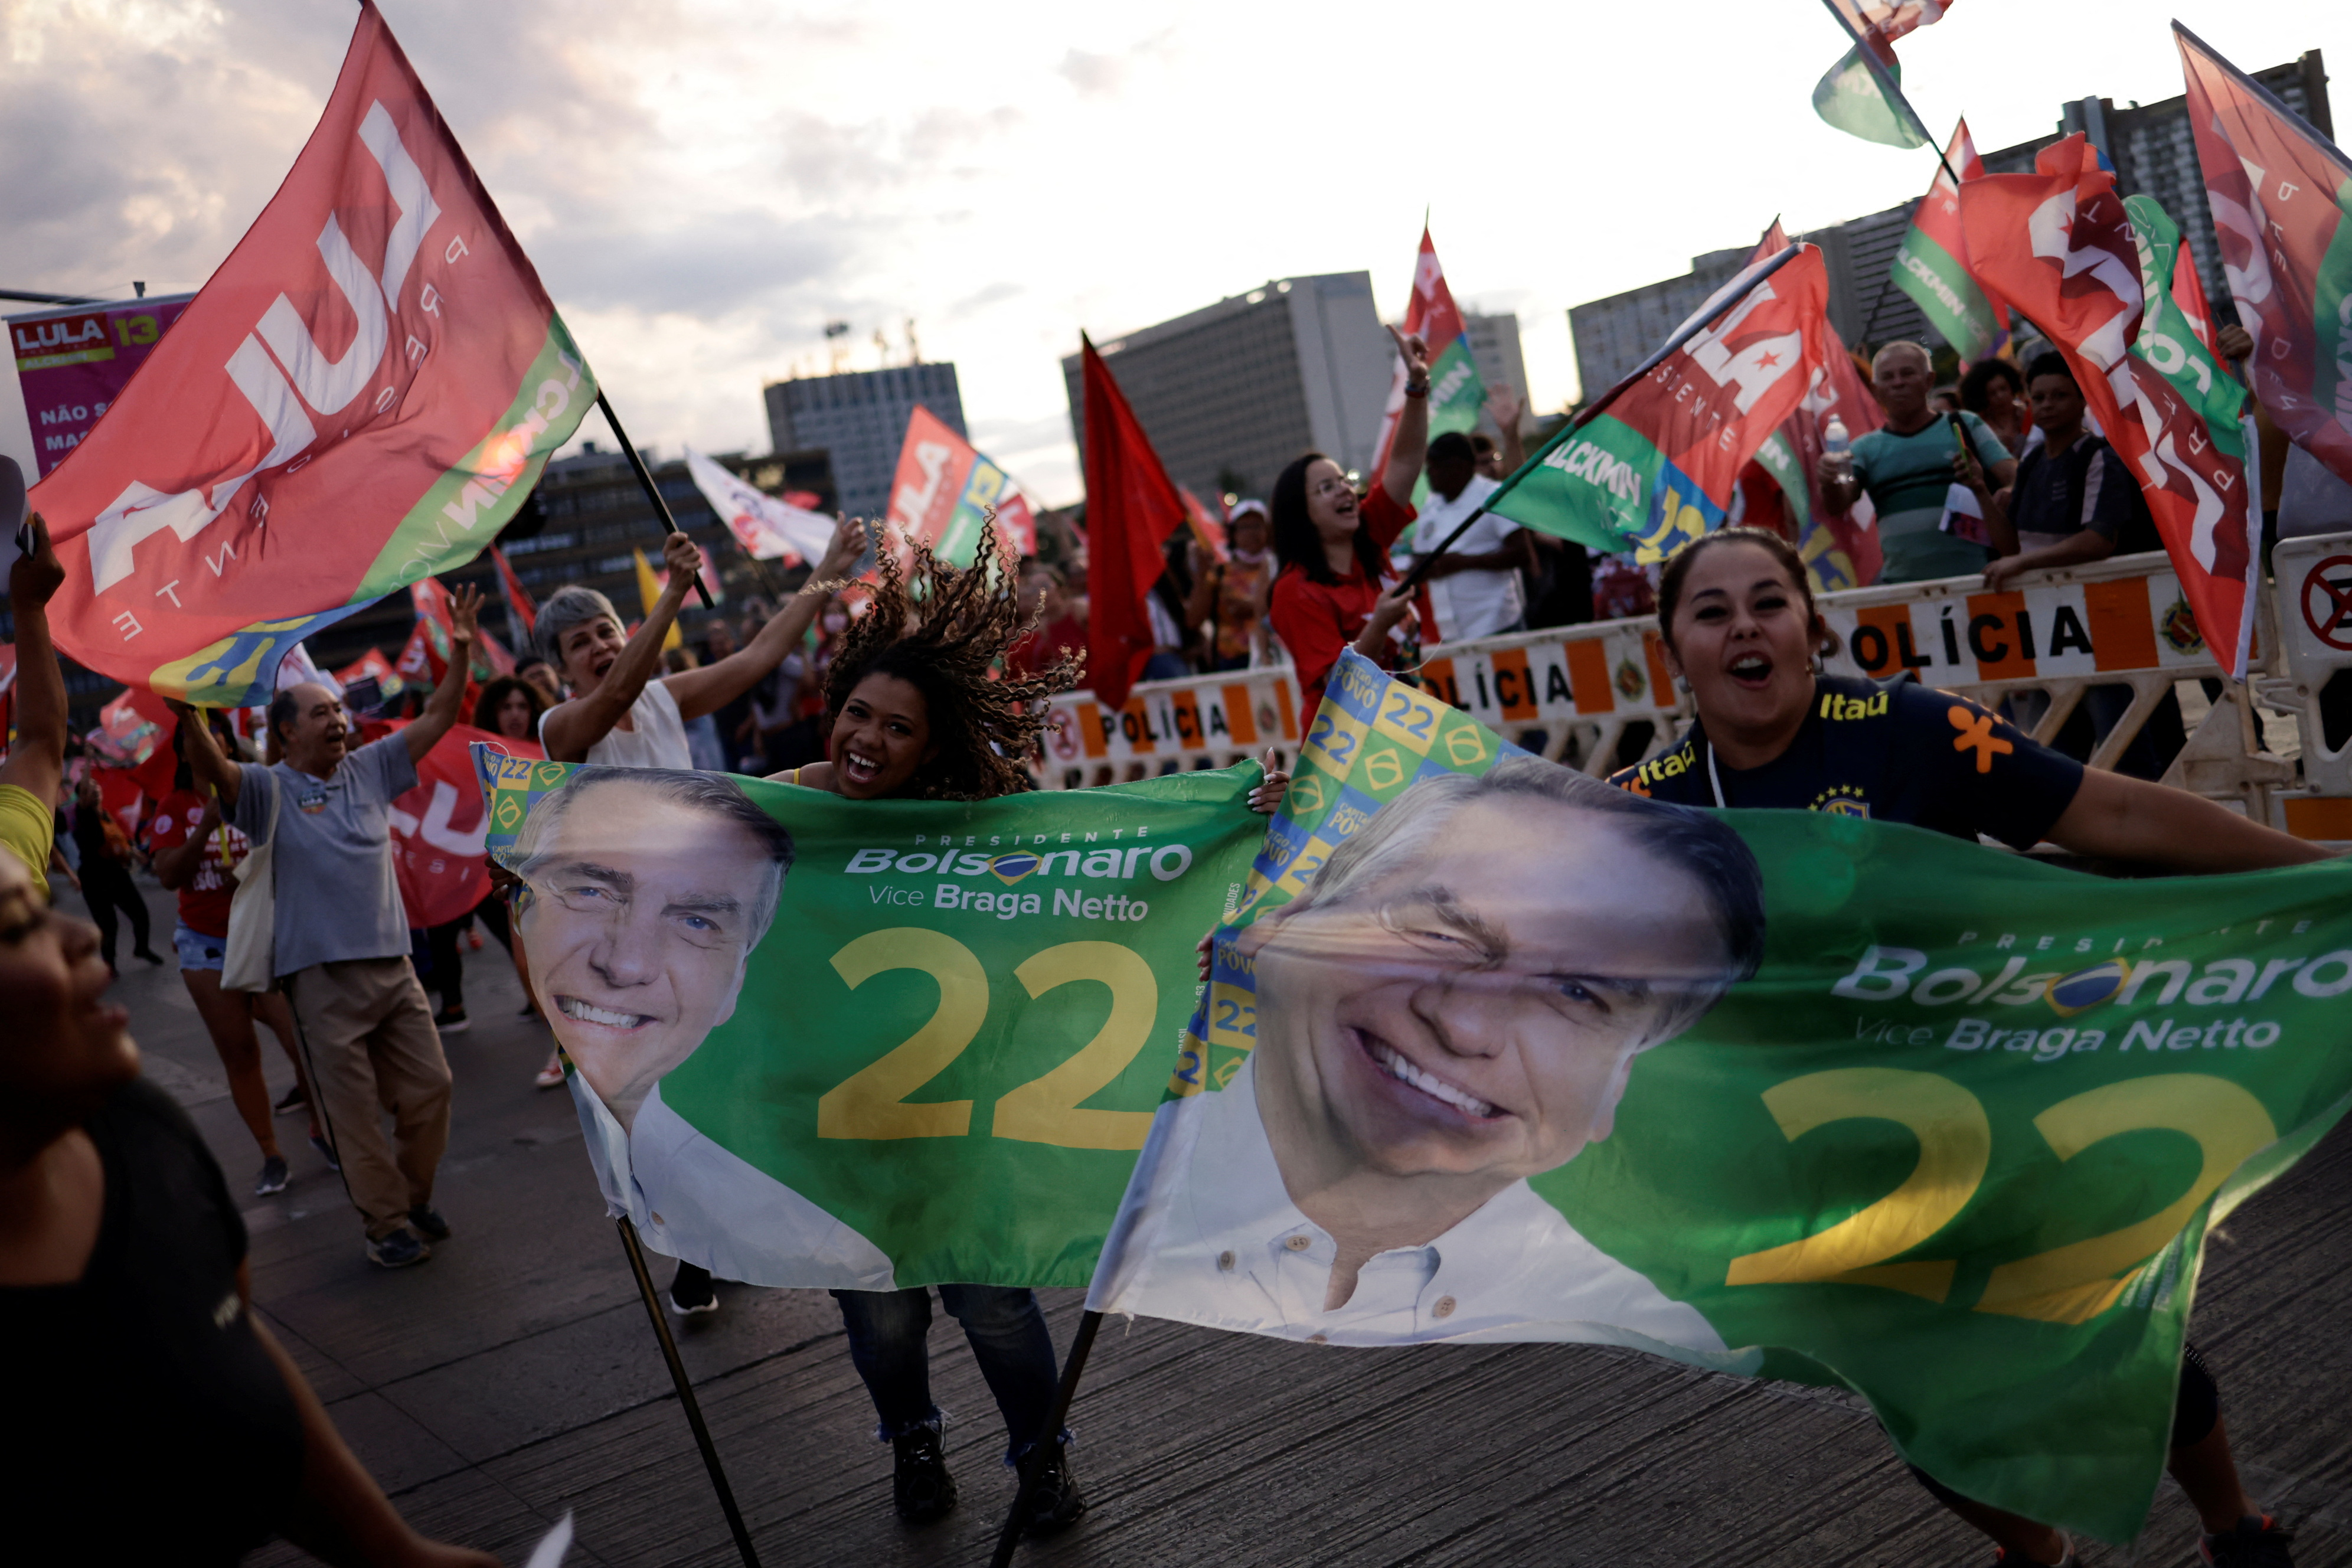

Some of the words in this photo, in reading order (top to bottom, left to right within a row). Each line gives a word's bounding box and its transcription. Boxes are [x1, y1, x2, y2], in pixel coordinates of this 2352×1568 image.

[16, 319, 104, 349] LULA
[115, 315, 159, 347] 13
[40, 404, 87, 425] NÃO
[94, 402, 113, 417] S
[1849, 605, 2094, 671] OLÍCIA
[1332, 665, 1377, 709] POVO
[1819, 691, 1889, 721] Itaú
[1384, 692, 1435, 741] 22
[1308, 714, 1356, 766] 22
[501, 759, 531, 780] 22
[1638, 740, 1697, 786] Itaú
[915, 826, 1148, 847] PRESIDENTE
[844, 844, 1193, 884] Bolsonaro
[869, 885, 924, 906] Vice
[934, 884, 1041, 920] Braga
[1052, 888, 1149, 922] Netto
[1830, 945, 2352, 1014] Bolsonaro
[818, 927, 1158, 1151] 22
[1854, 1016, 1934, 1045] Vice
[1945, 1018, 2107, 1062] Braga
[2119, 1018, 2282, 1053] Netto
[1724, 1067, 2278, 1326] 22
